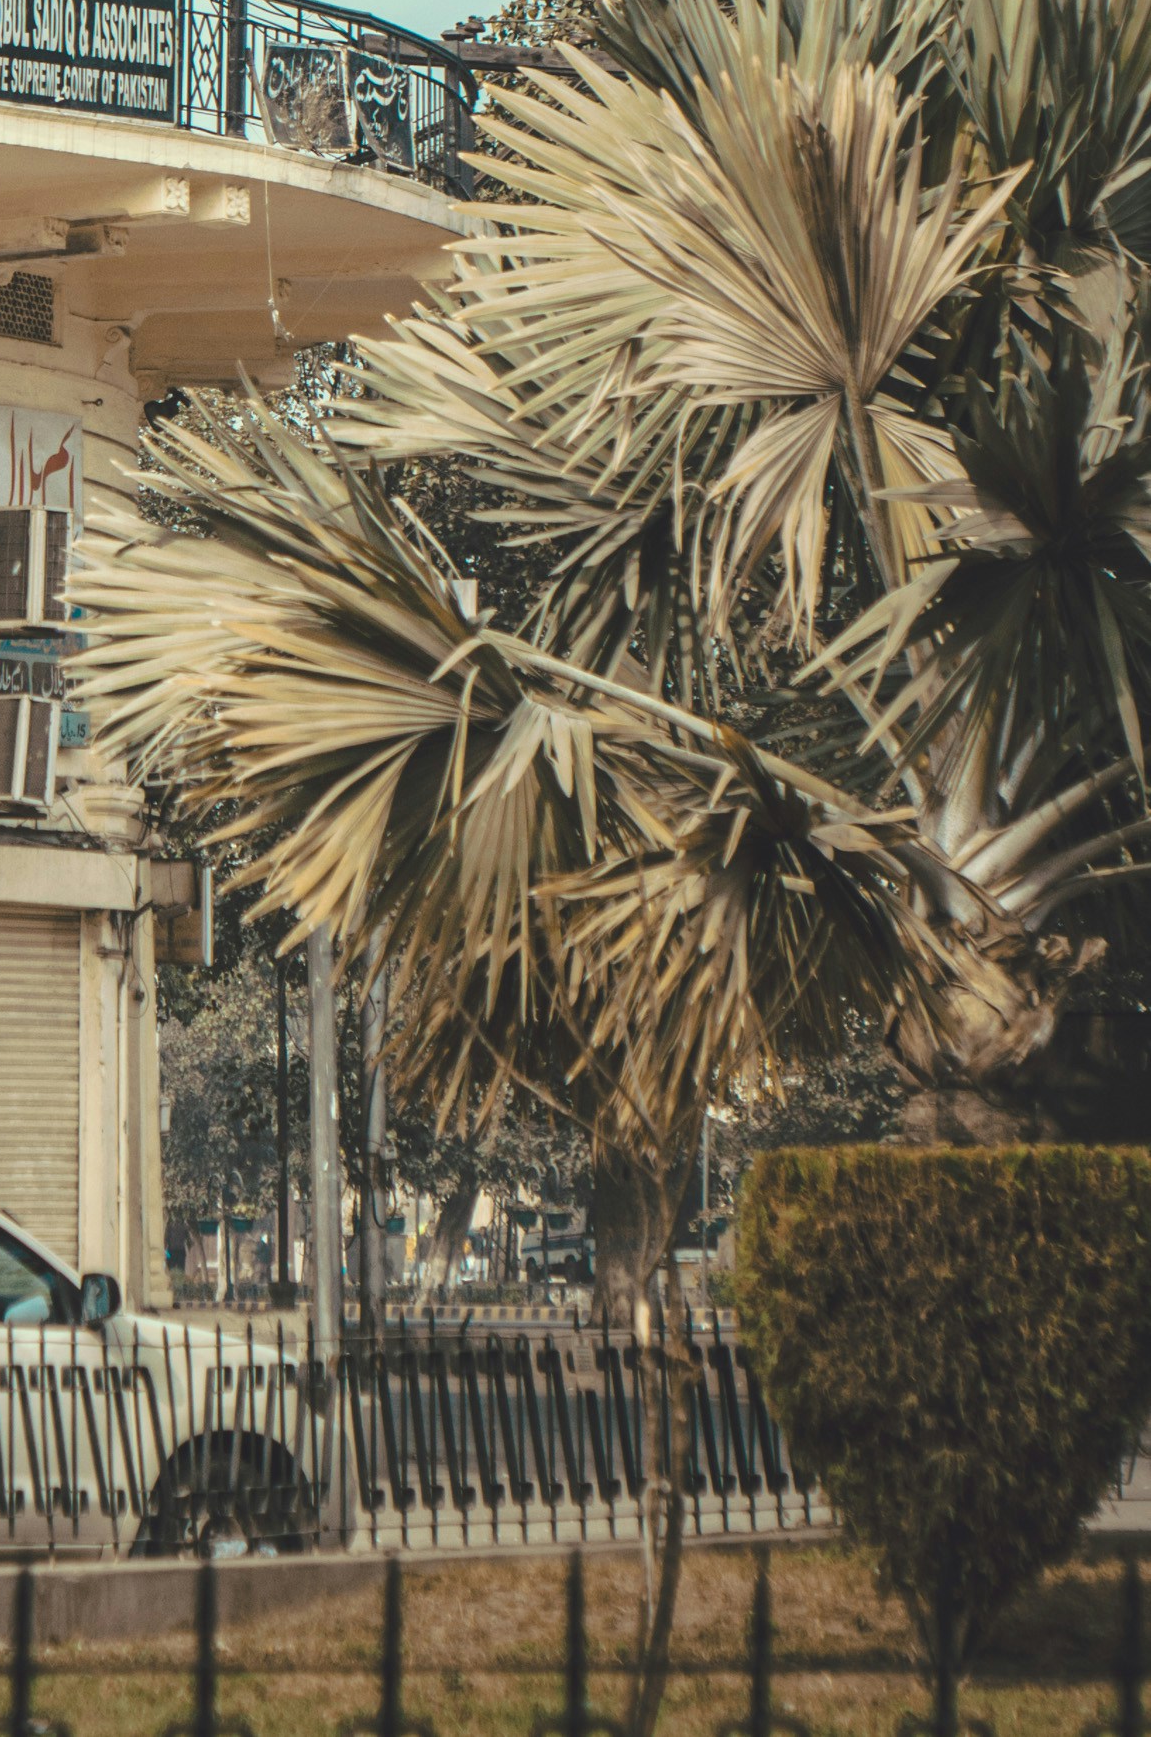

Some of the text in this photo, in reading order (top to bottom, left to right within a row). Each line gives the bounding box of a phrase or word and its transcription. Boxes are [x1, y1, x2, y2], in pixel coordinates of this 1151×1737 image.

[78, 0, 89, 58] &
[92, 1, 174, 68] ASSOCIATES
[11, 58, 62, 97] SUPREME
[63, 65, 100, 103] COURT
[101, 70, 116, 105] OF
[117, 73, 168, 112] PAKISTAN
